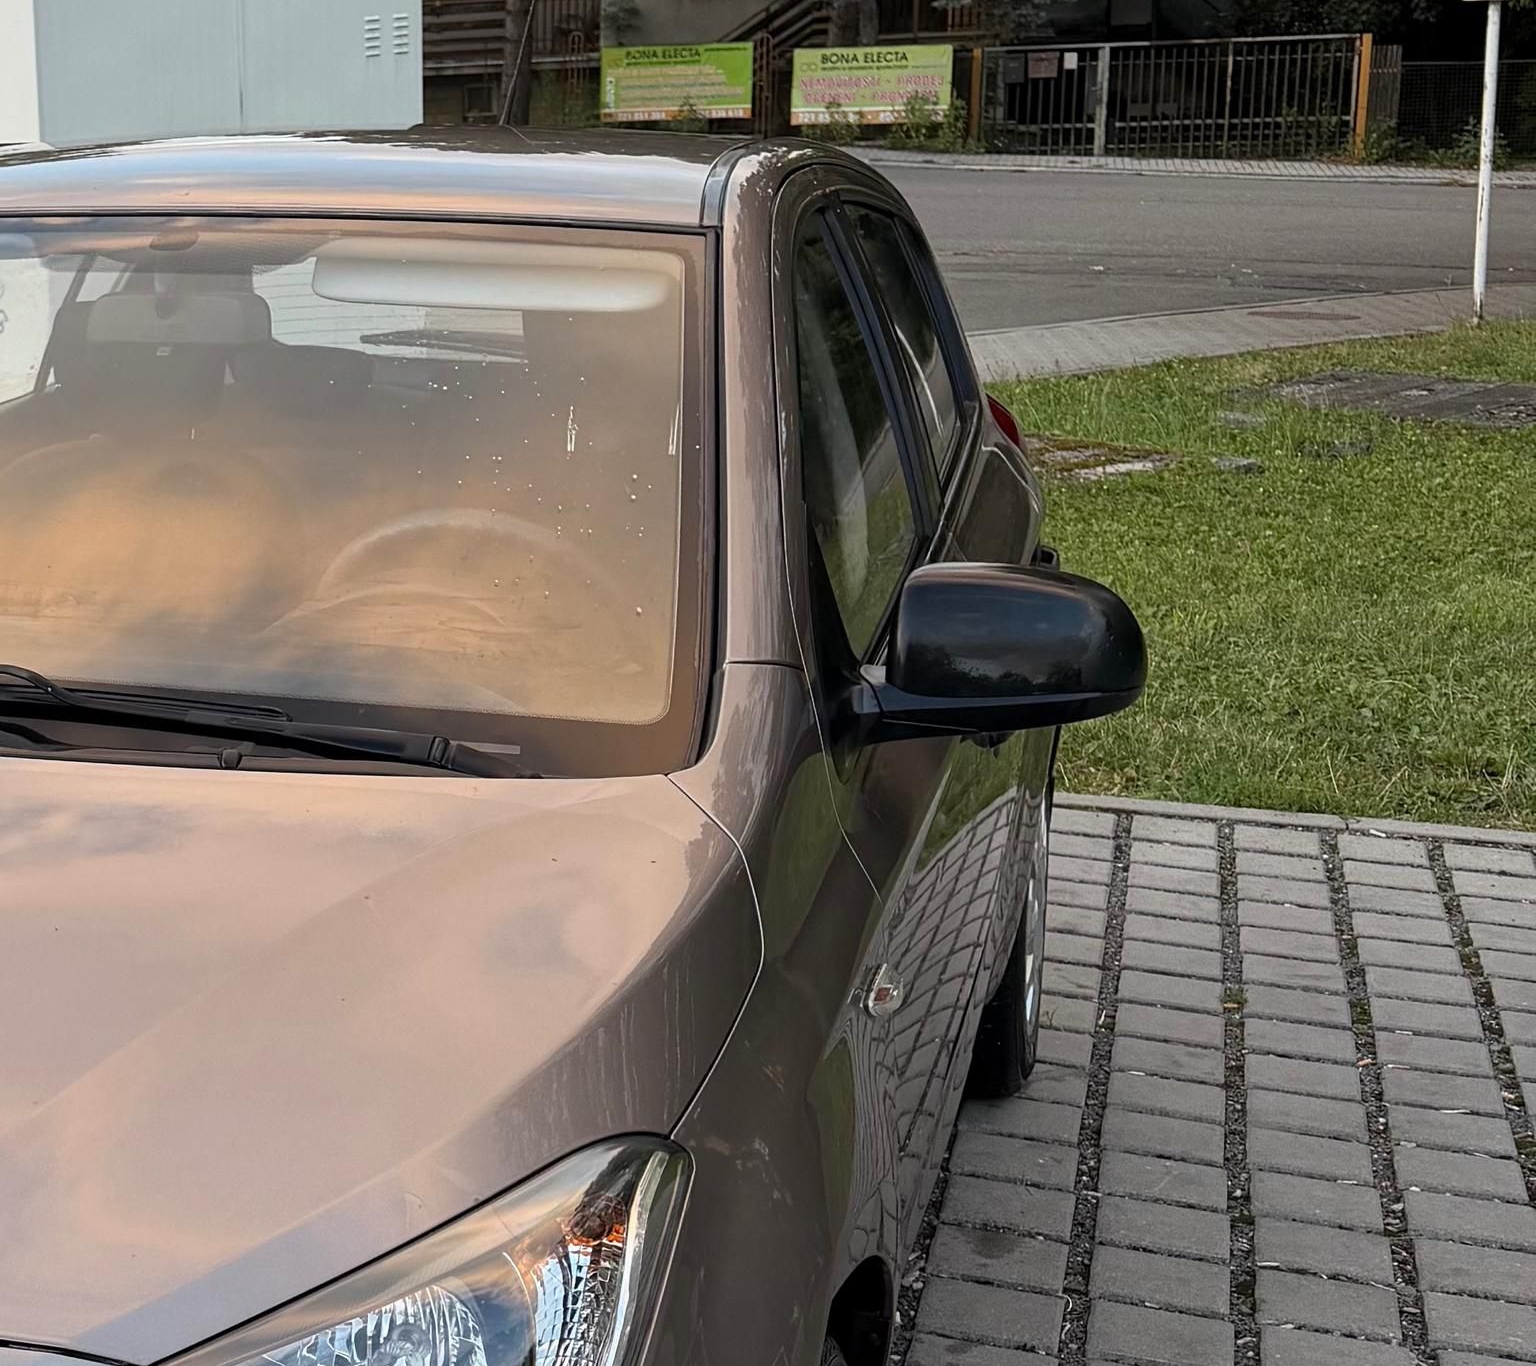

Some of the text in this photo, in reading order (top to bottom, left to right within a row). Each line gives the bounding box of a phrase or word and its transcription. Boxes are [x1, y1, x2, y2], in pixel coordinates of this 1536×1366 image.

[625, 49, 658, 61] BONA
[662, 47, 701, 60] ELECTA
[820, 50, 909, 65] BONA ELECTA
